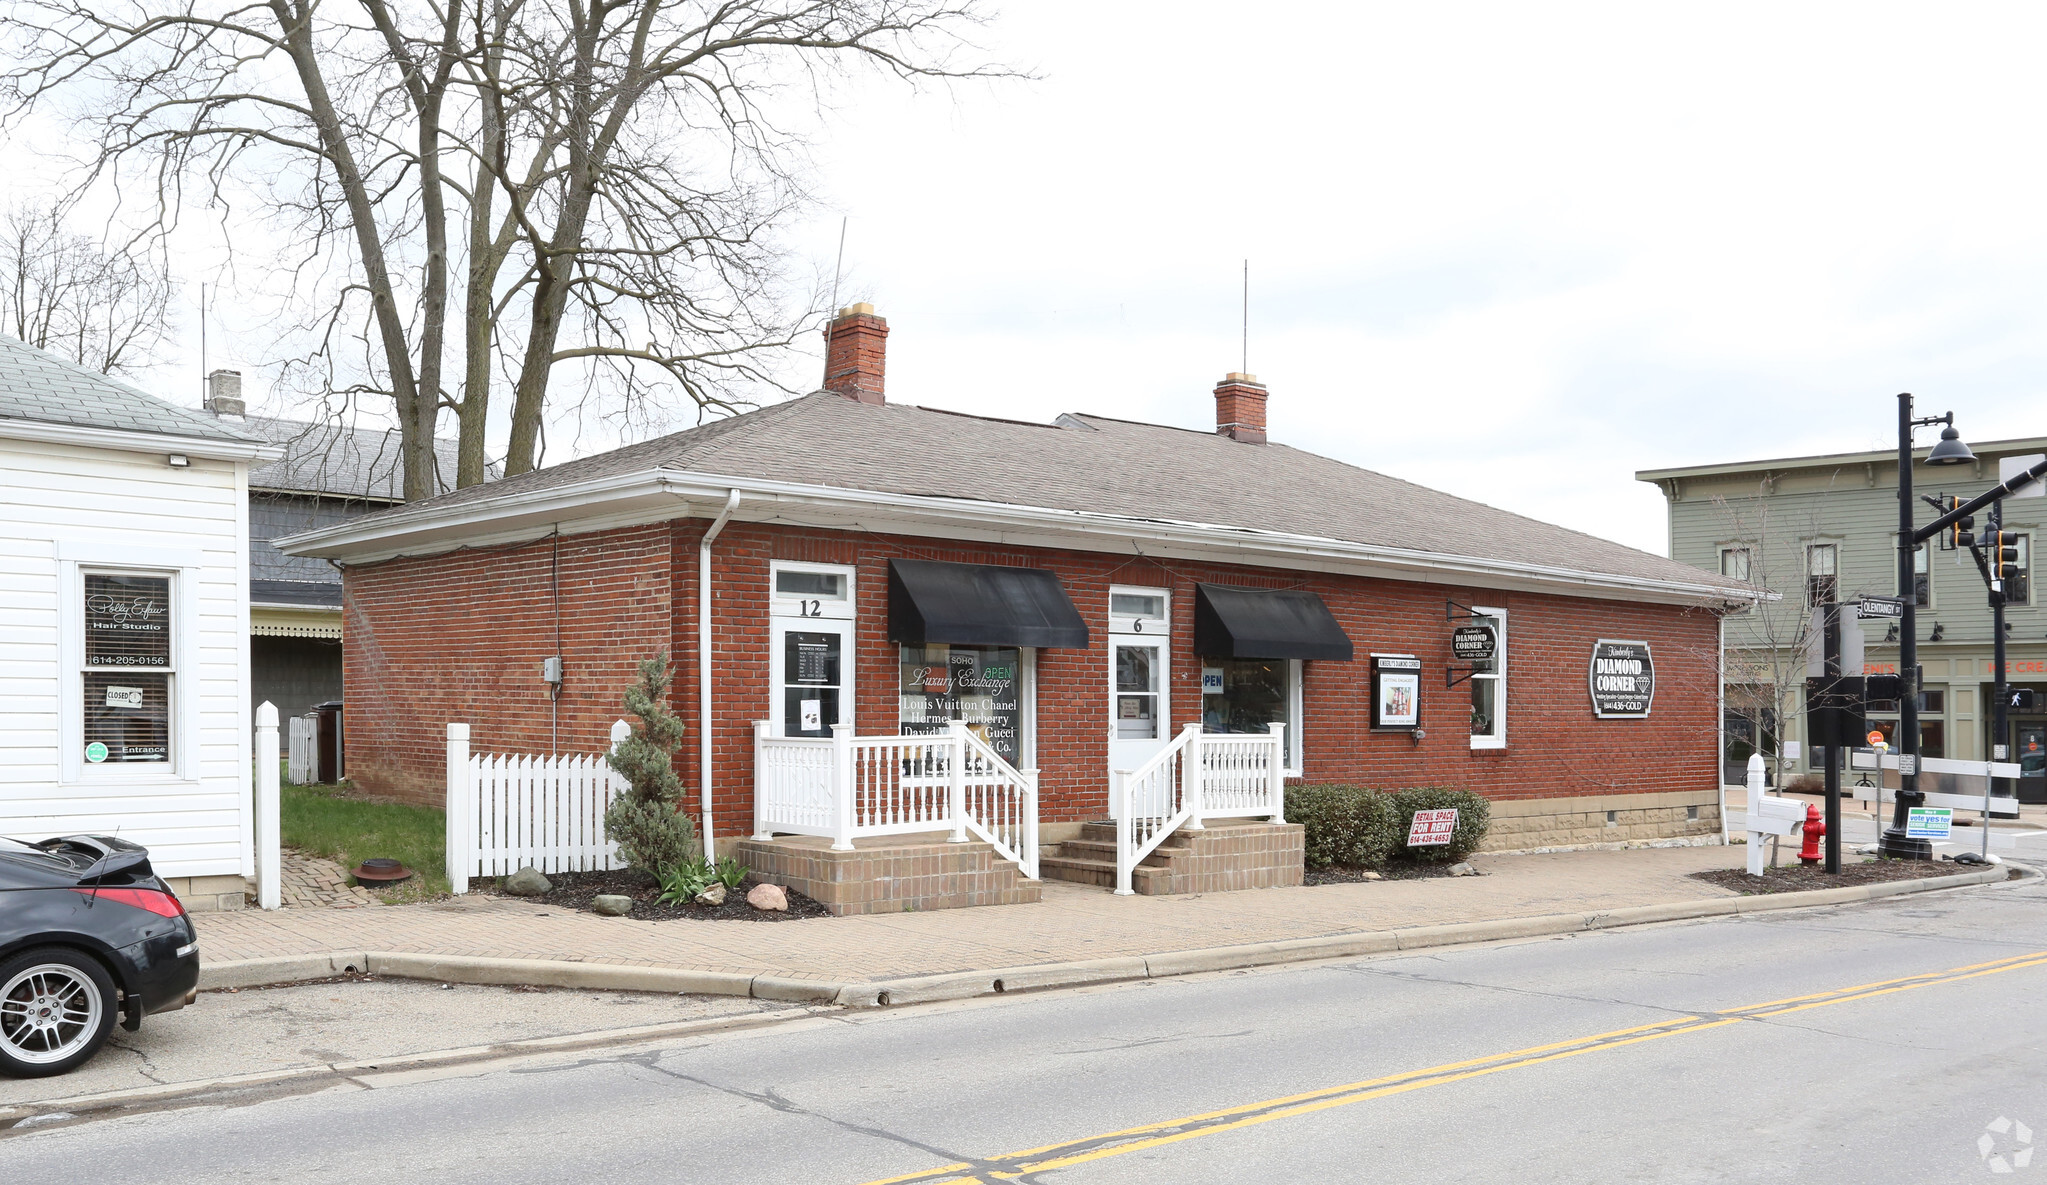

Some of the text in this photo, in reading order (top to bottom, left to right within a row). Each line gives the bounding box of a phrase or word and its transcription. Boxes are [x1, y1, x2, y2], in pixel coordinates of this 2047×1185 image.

[800, 600, 821, 617] 12
[1863, 602, 1895, 614] OLENTANGY
[1133, 618, 1142, 632] 6
[1455, 634, 1487, 642] DIAMOND
[1455, 642, 1483, 650] CORNER
[1608, 645, 1634, 659] Kimberly's
[92, 656, 164, 665] 614-205-0156
[951, 656, 974, 665] SOHO
[1596, 658, 1642, 675] DIAMOND
[1988, 661, 2047, 673] IE CRE
[985, 667, 1011, 679] OPEN
[908, 666, 1011, 697] Luxury Exchange
[1203, 674, 1222, 687] PEN
[1596, 675, 1636, 692] CORNER
[107, 691, 129, 700] CLOSED
[903, 697, 1017, 711] Louis Vuitton Chanel
[911, 711, 1009, 727] Hermes Burberry
[904, 726, 936, 736] David
[985, 726, 1014, 739] Gucci
[996, 740, 1012, 753] Co.
[1416, 811, 1455, 821] RETAIL SPACE
[1926, 816, 1940, 824] yes
[1412, 821, 1452, 834] FOR RENT
[1410, 834, 1450, 844] 614-436-4653
